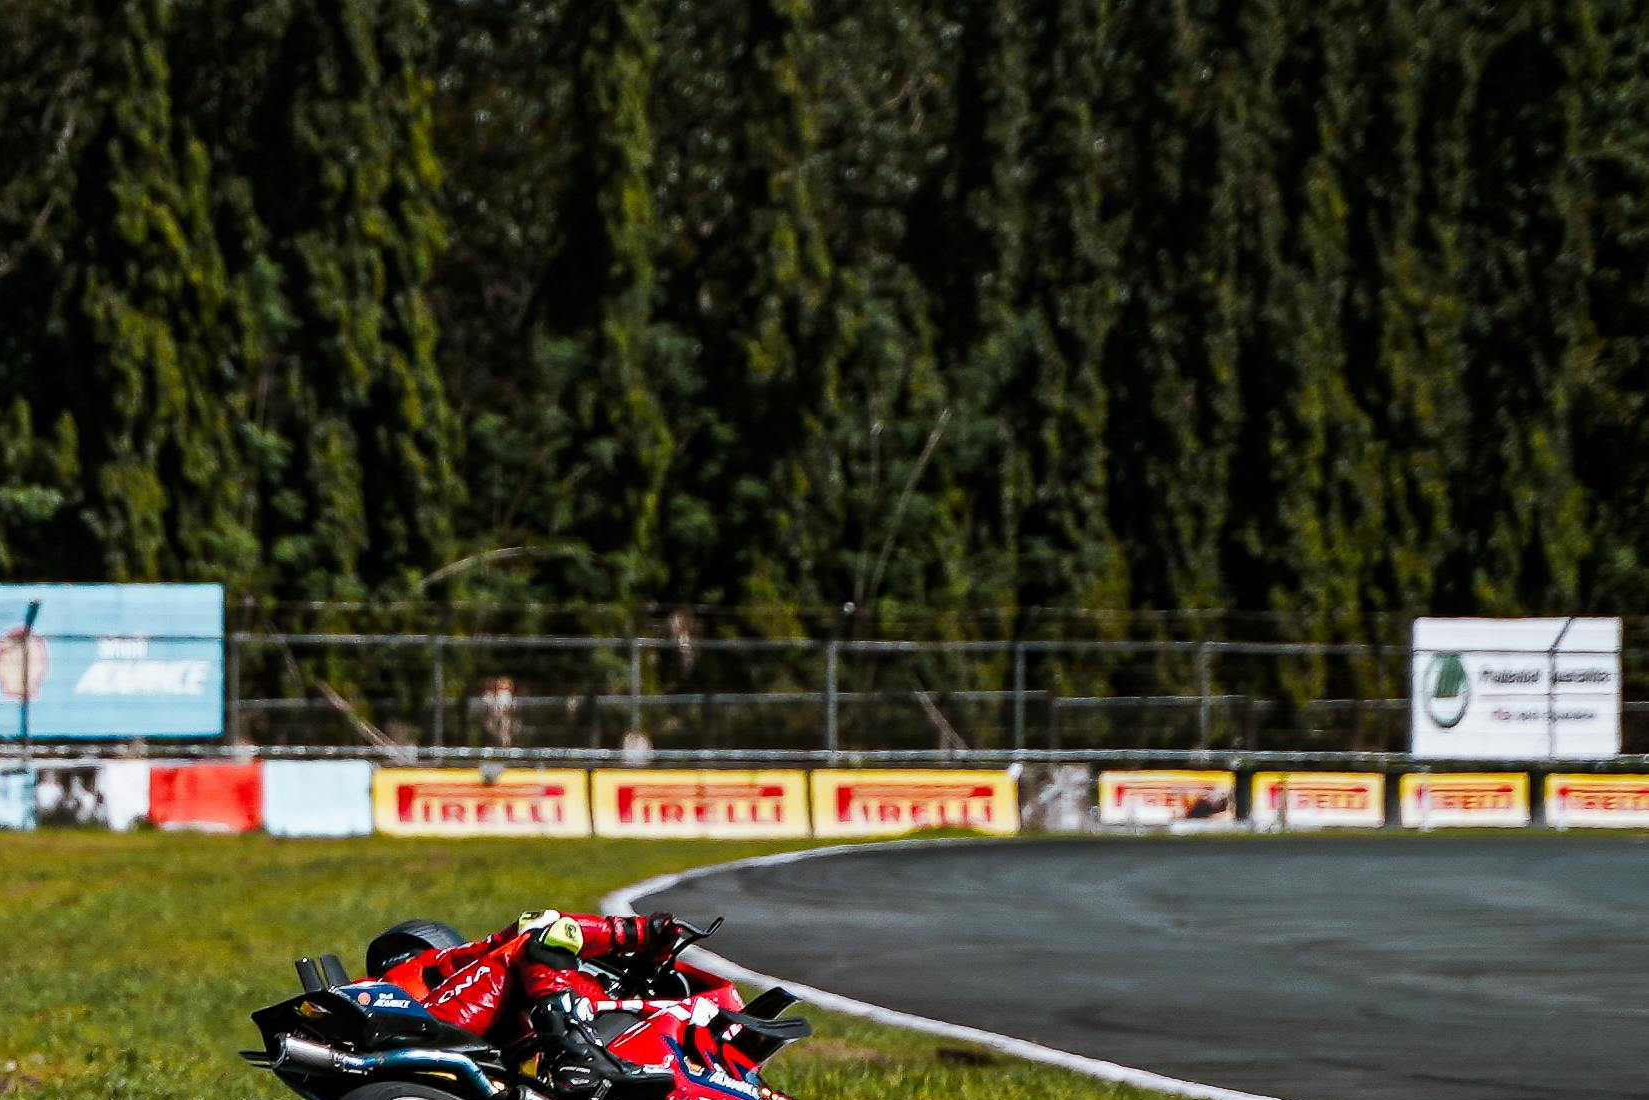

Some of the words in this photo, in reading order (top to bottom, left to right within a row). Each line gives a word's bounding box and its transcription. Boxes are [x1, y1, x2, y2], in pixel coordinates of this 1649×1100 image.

[397, 784, 564, 824] PIRELLI
[617, 785, 785, 824] PIRELLI
[837, 785, 994, 826] PIRELLI
